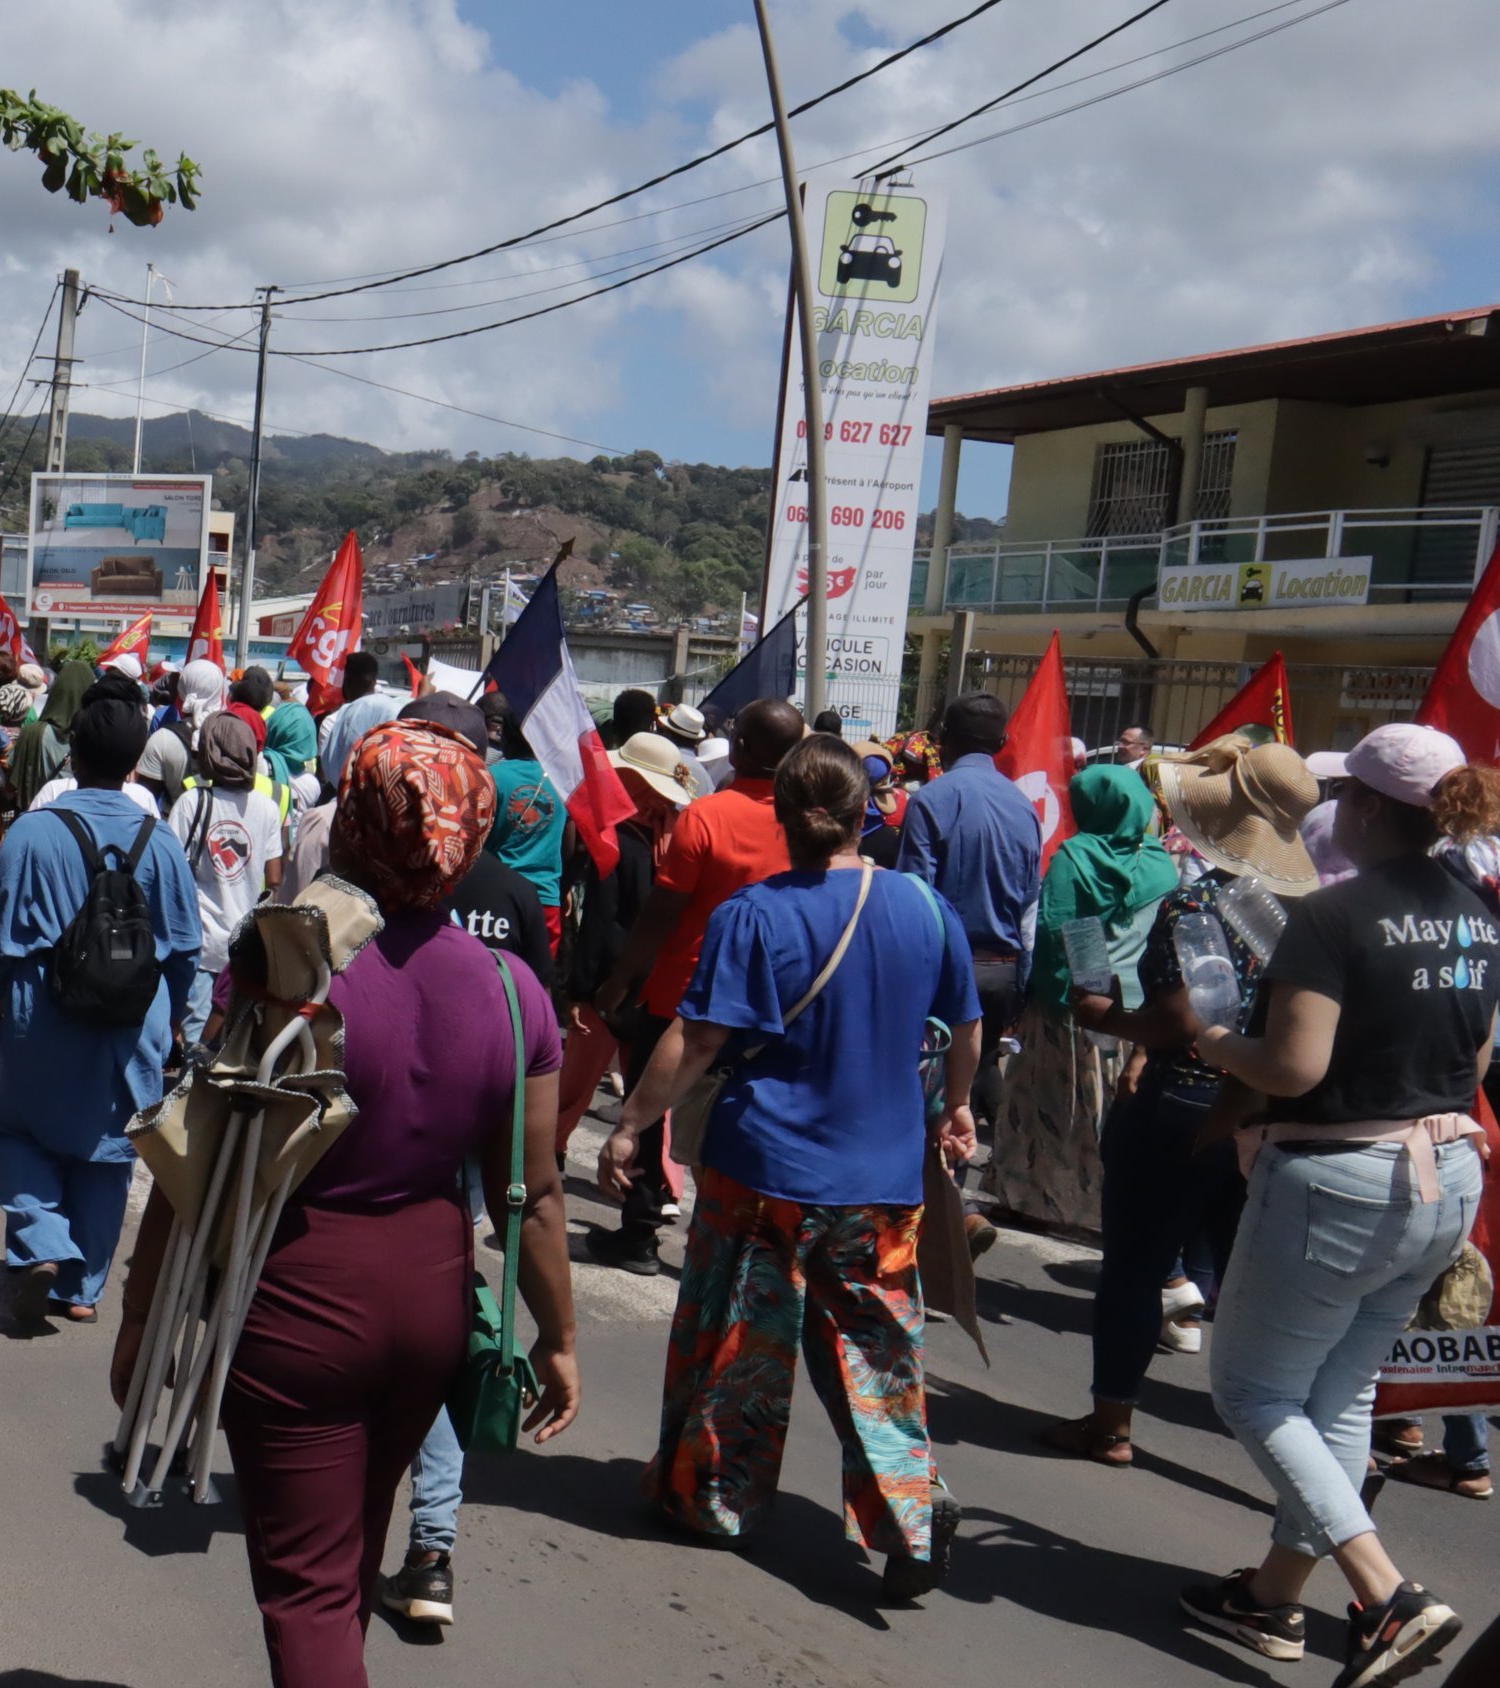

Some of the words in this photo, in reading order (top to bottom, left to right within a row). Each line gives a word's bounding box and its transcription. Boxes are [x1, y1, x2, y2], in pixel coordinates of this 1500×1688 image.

[812, 306, 924, 341] GARCIA
[818, 359, 919, 384] ocation
[796, 420, 834, 441] 09
[840, 420, 873, 444] 627
[879, 423, 913, 446] 627
[824, 475, 857, 487] résent
[867, 478, 914, 491] l'Aéroport
[831, 505, 864, 528] 690
[871, 508, 906, 531] 206
[831, 554, 844, 564] de
[864, 580, 888, 591] jour
[865, 569, 885, 580] par
[1161, 574, 1233, 604] GARCIA
[1275, 567, 1368, 600] Location
[852, 613, 895, 626] ILLIMITÉ
[795, 635, 874, 655] VICULE
[1411, 967, 1431, 991] a
[1385, 1335, 1500, 1363] AOBAB
